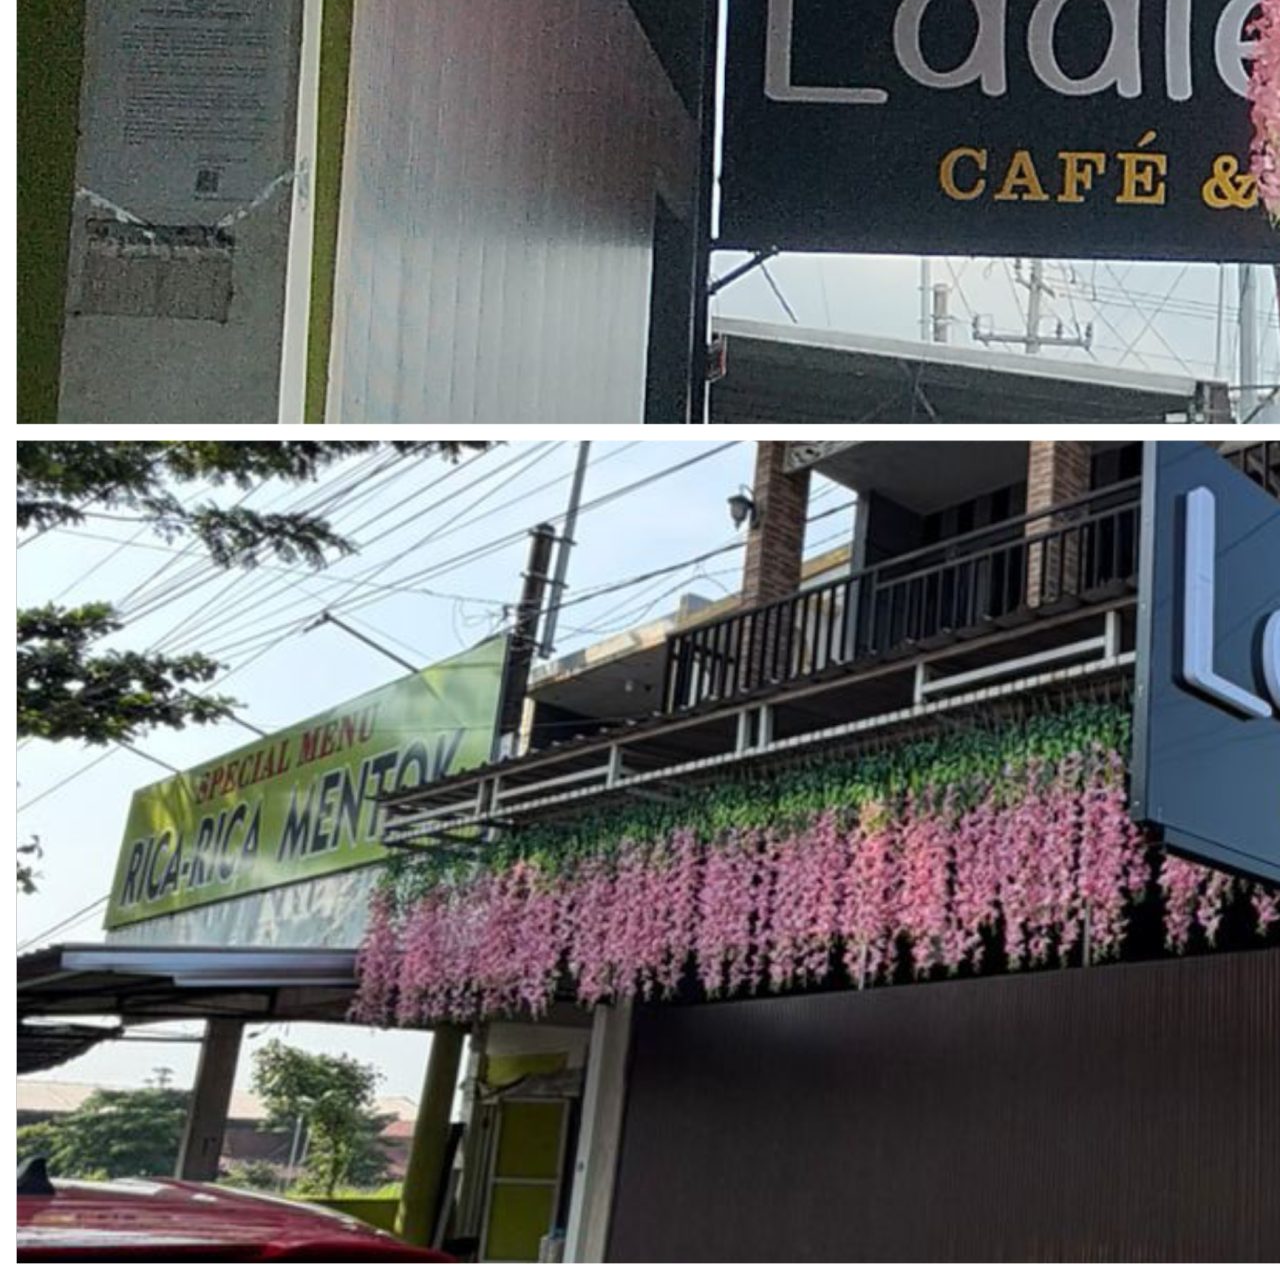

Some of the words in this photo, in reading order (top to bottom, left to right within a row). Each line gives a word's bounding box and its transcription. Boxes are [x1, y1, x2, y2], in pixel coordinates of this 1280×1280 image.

[940, 130, 1168, 205] CAFÉ
[1202, 154, 1262, 210] &
[196, 737, 292, 805] SPECIAL
[297, 703, 380, 766] MENU
[118, 795, 265, 908] RICA-RICA
